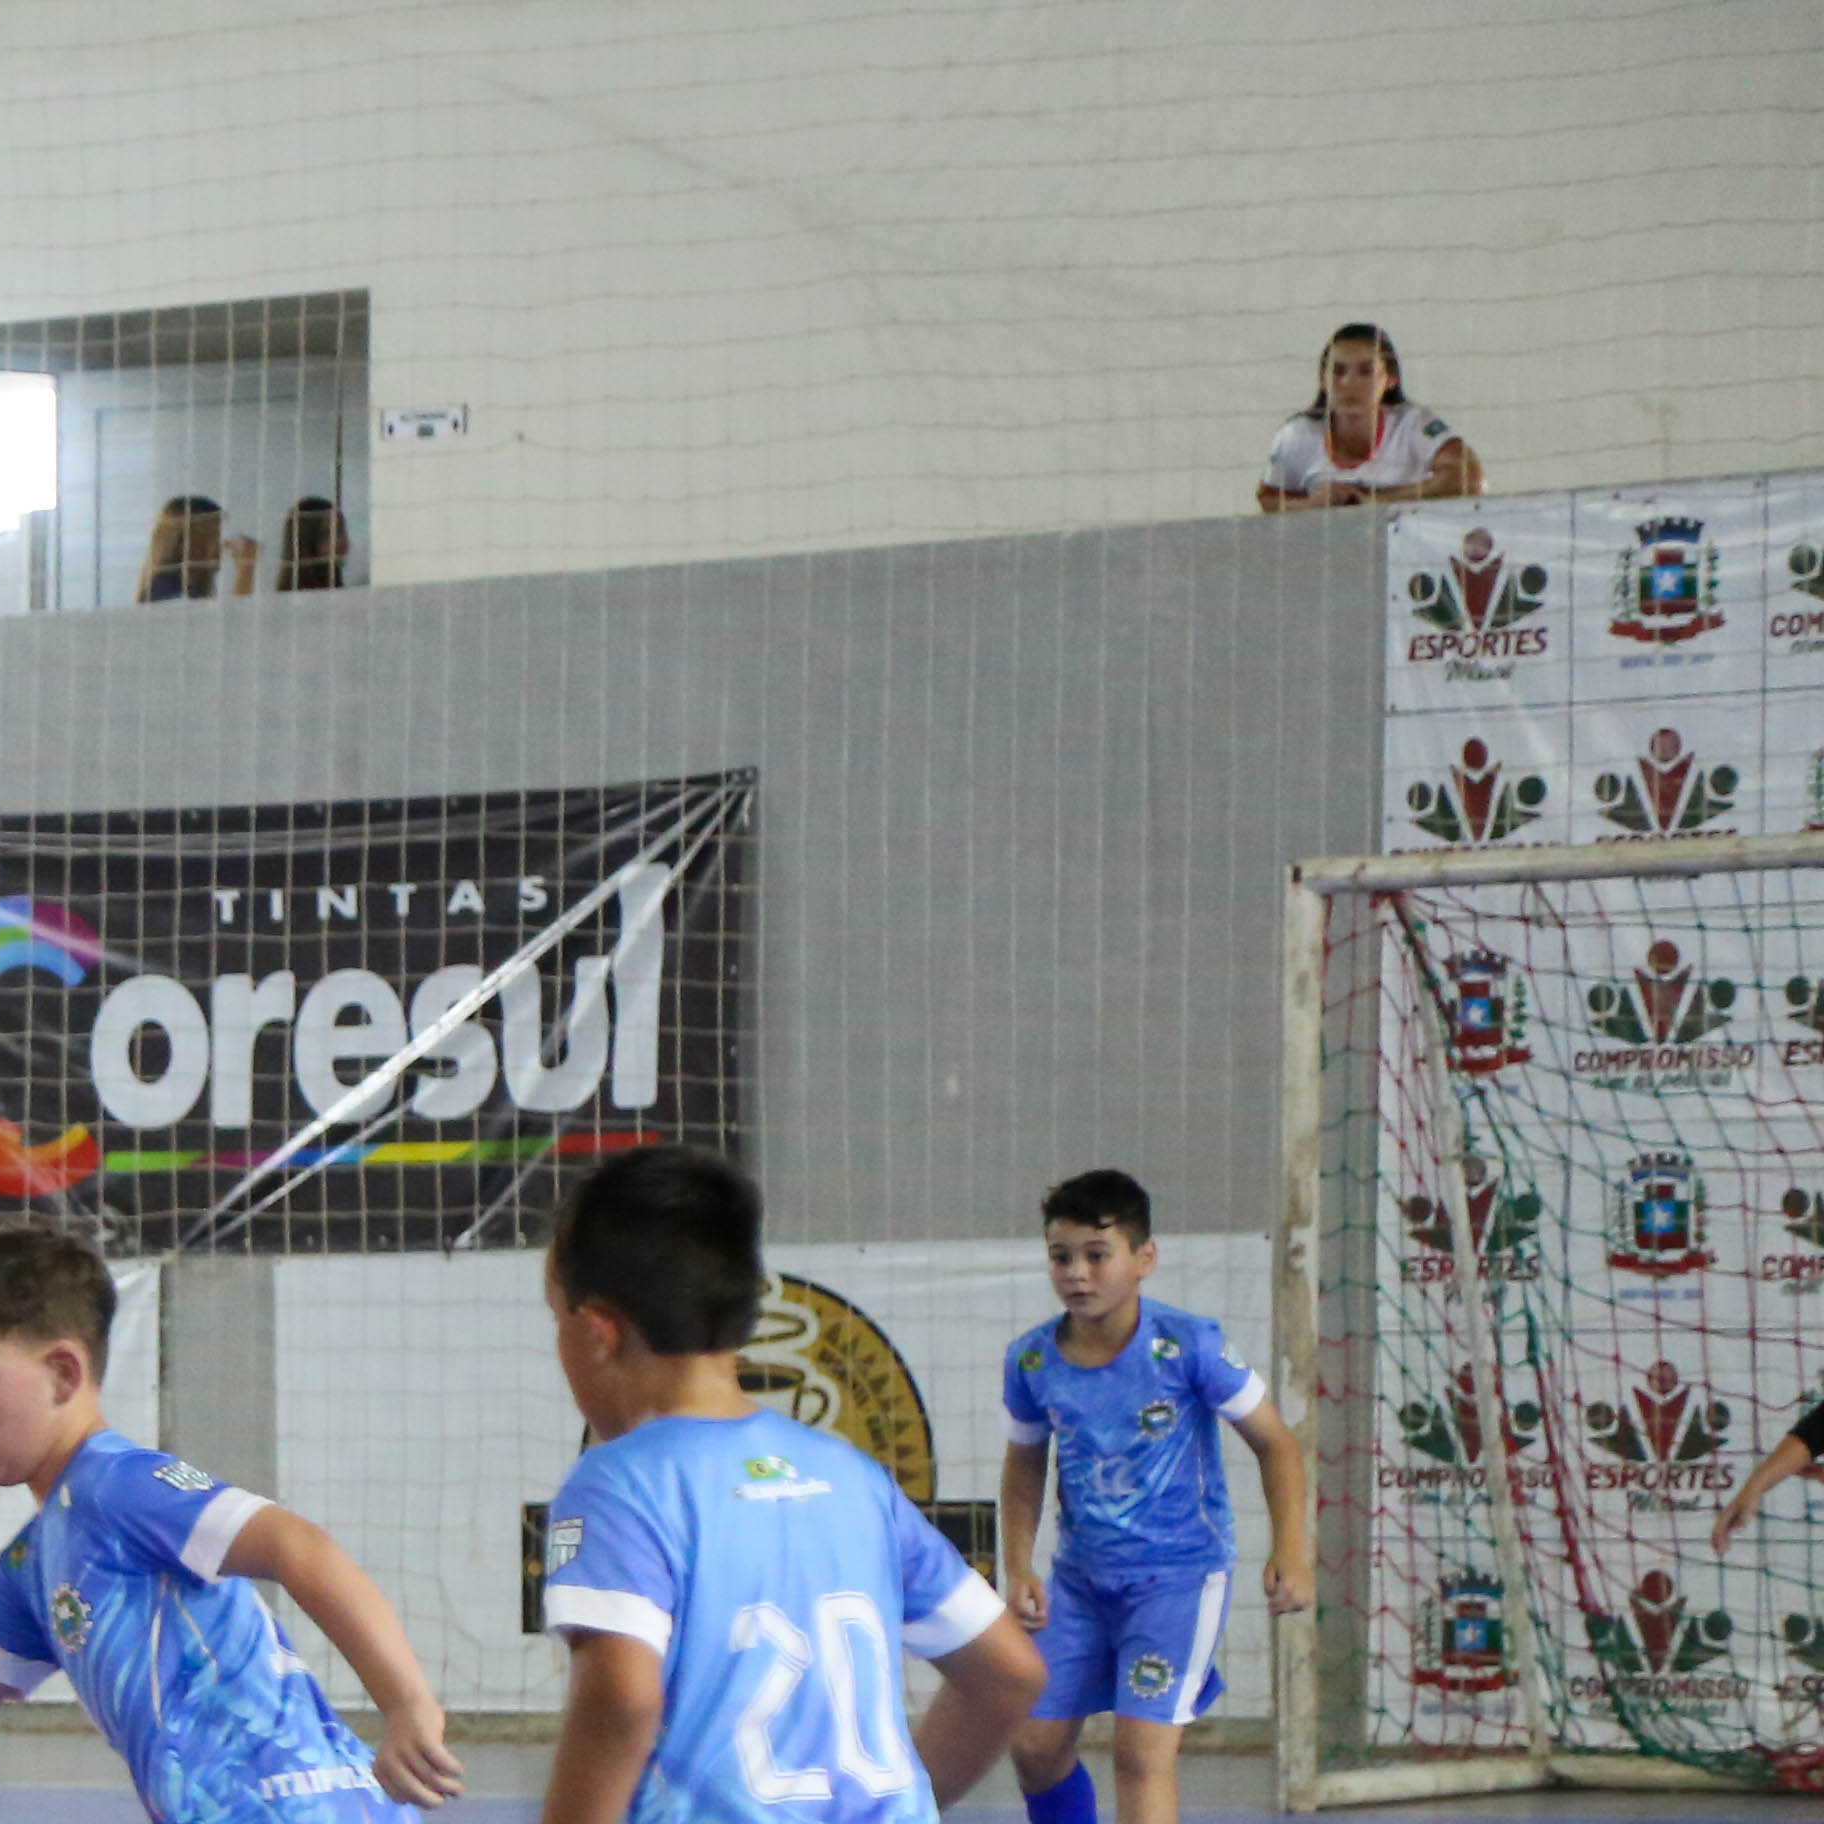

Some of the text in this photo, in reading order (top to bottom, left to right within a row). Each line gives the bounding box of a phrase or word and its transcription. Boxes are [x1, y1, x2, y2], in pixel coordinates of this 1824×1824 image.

[1408, 627, 1548, 661] ESPORTES
[213, 874, 550, 924] TINTAS
[1587, 1464, 1736, 1490] ESPORTES
[730, 1591, 913, 1805] 20
